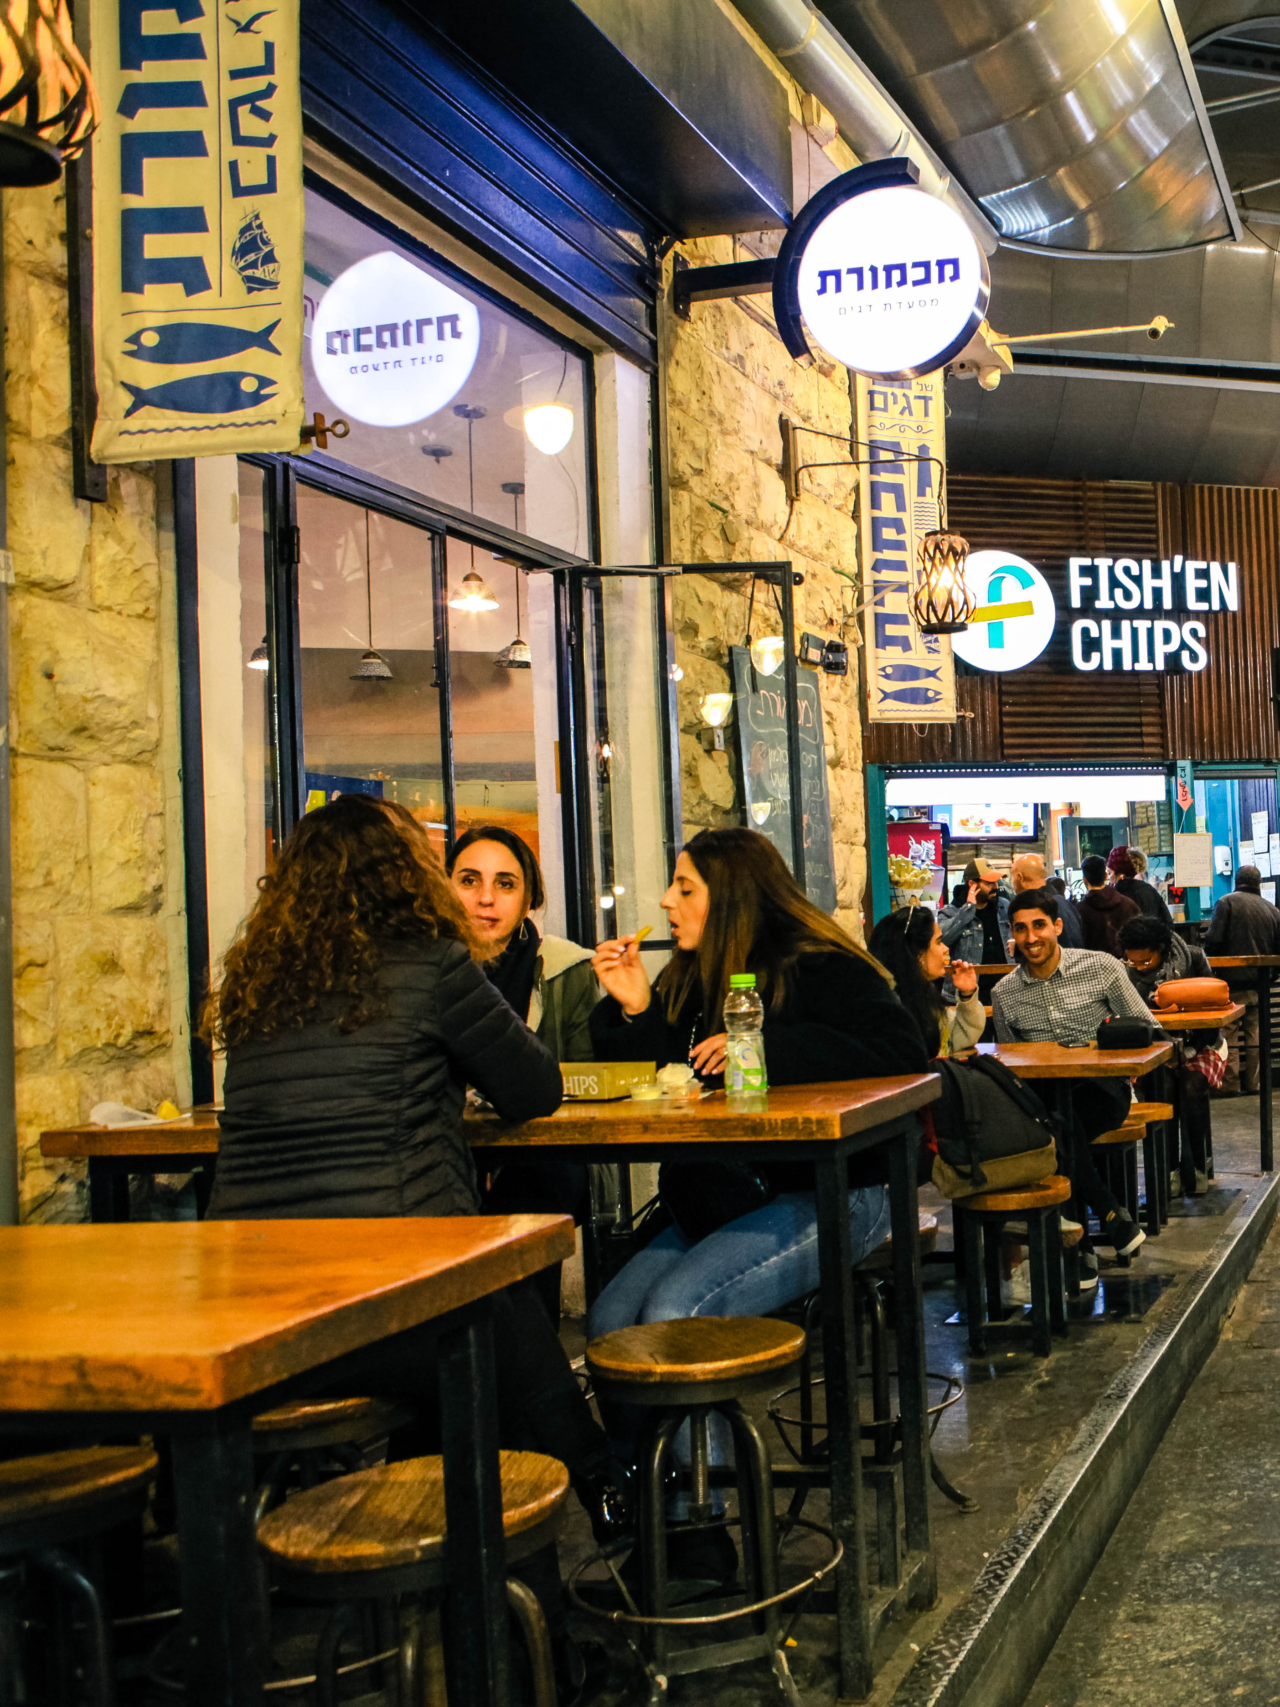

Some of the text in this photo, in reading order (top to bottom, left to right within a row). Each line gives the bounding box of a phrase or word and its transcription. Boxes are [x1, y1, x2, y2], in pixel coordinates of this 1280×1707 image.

[816, 257, 961, 297] מכמורת
[839, 298, 940, 316] מסעדת דגים
[916, 381, 934, 392] של
[867, 389, 934, 418] דגים
[1068, 555, 1239, 612] FISH'EN
[1070, 619, 1208, 672] CHIPS
[563, 1075, 599, 1095] HIPS
